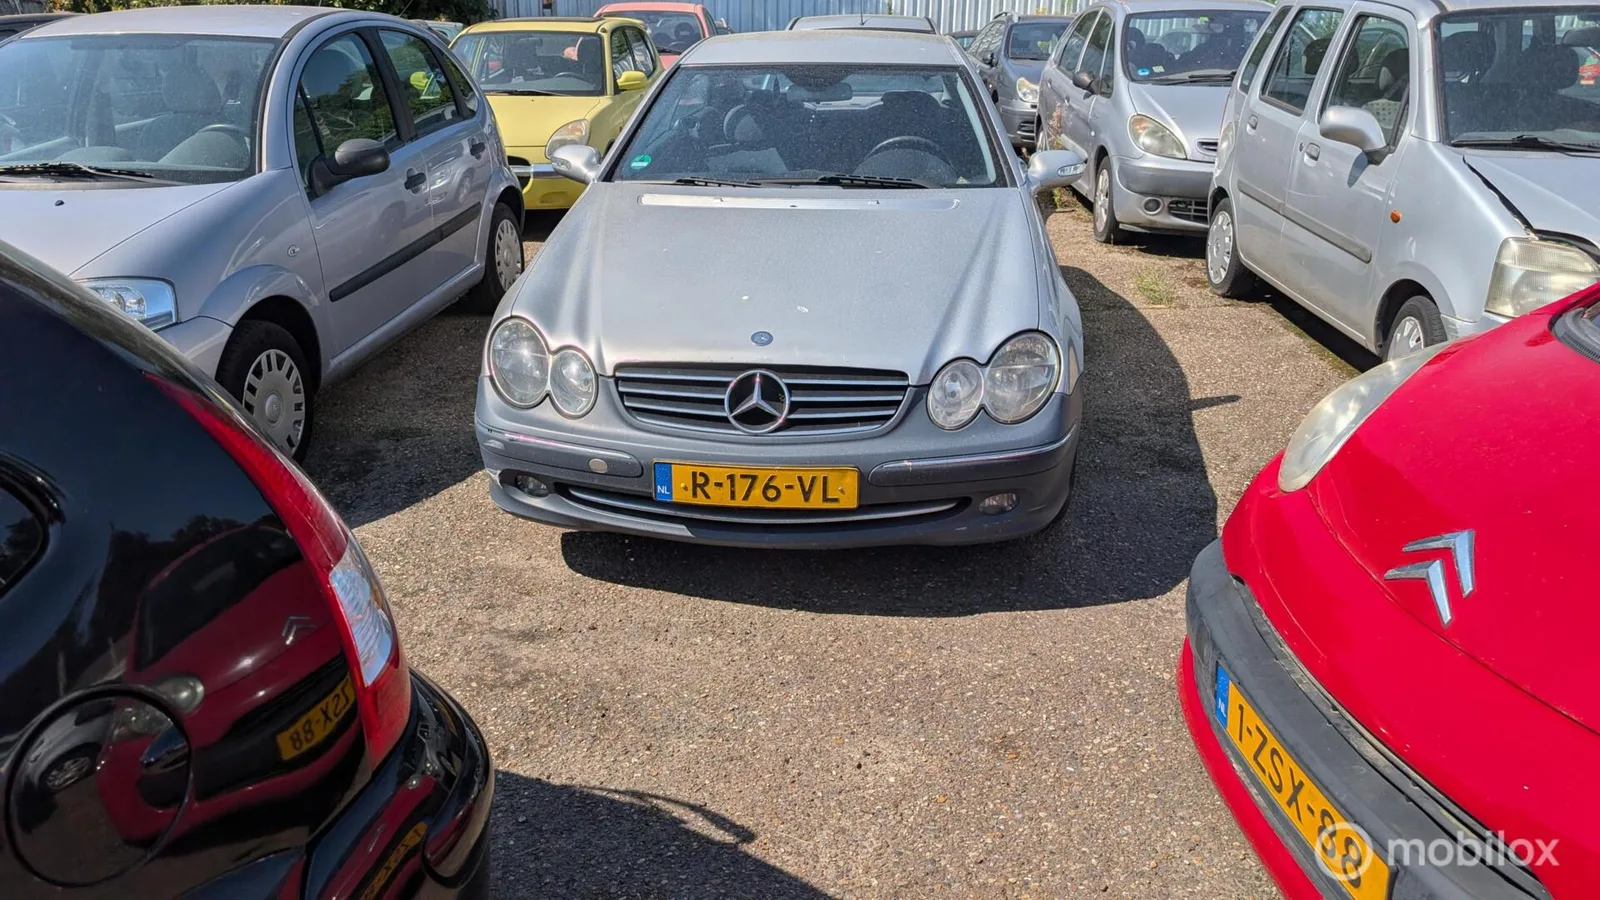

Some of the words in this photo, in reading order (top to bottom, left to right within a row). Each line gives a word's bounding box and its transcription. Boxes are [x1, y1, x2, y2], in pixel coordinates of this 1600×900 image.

[657, 484, 670, 495] NL
[691, 470, 839, 503] R-176-VL
[1237, 703, 1362, 889] 1-ZSX-88
